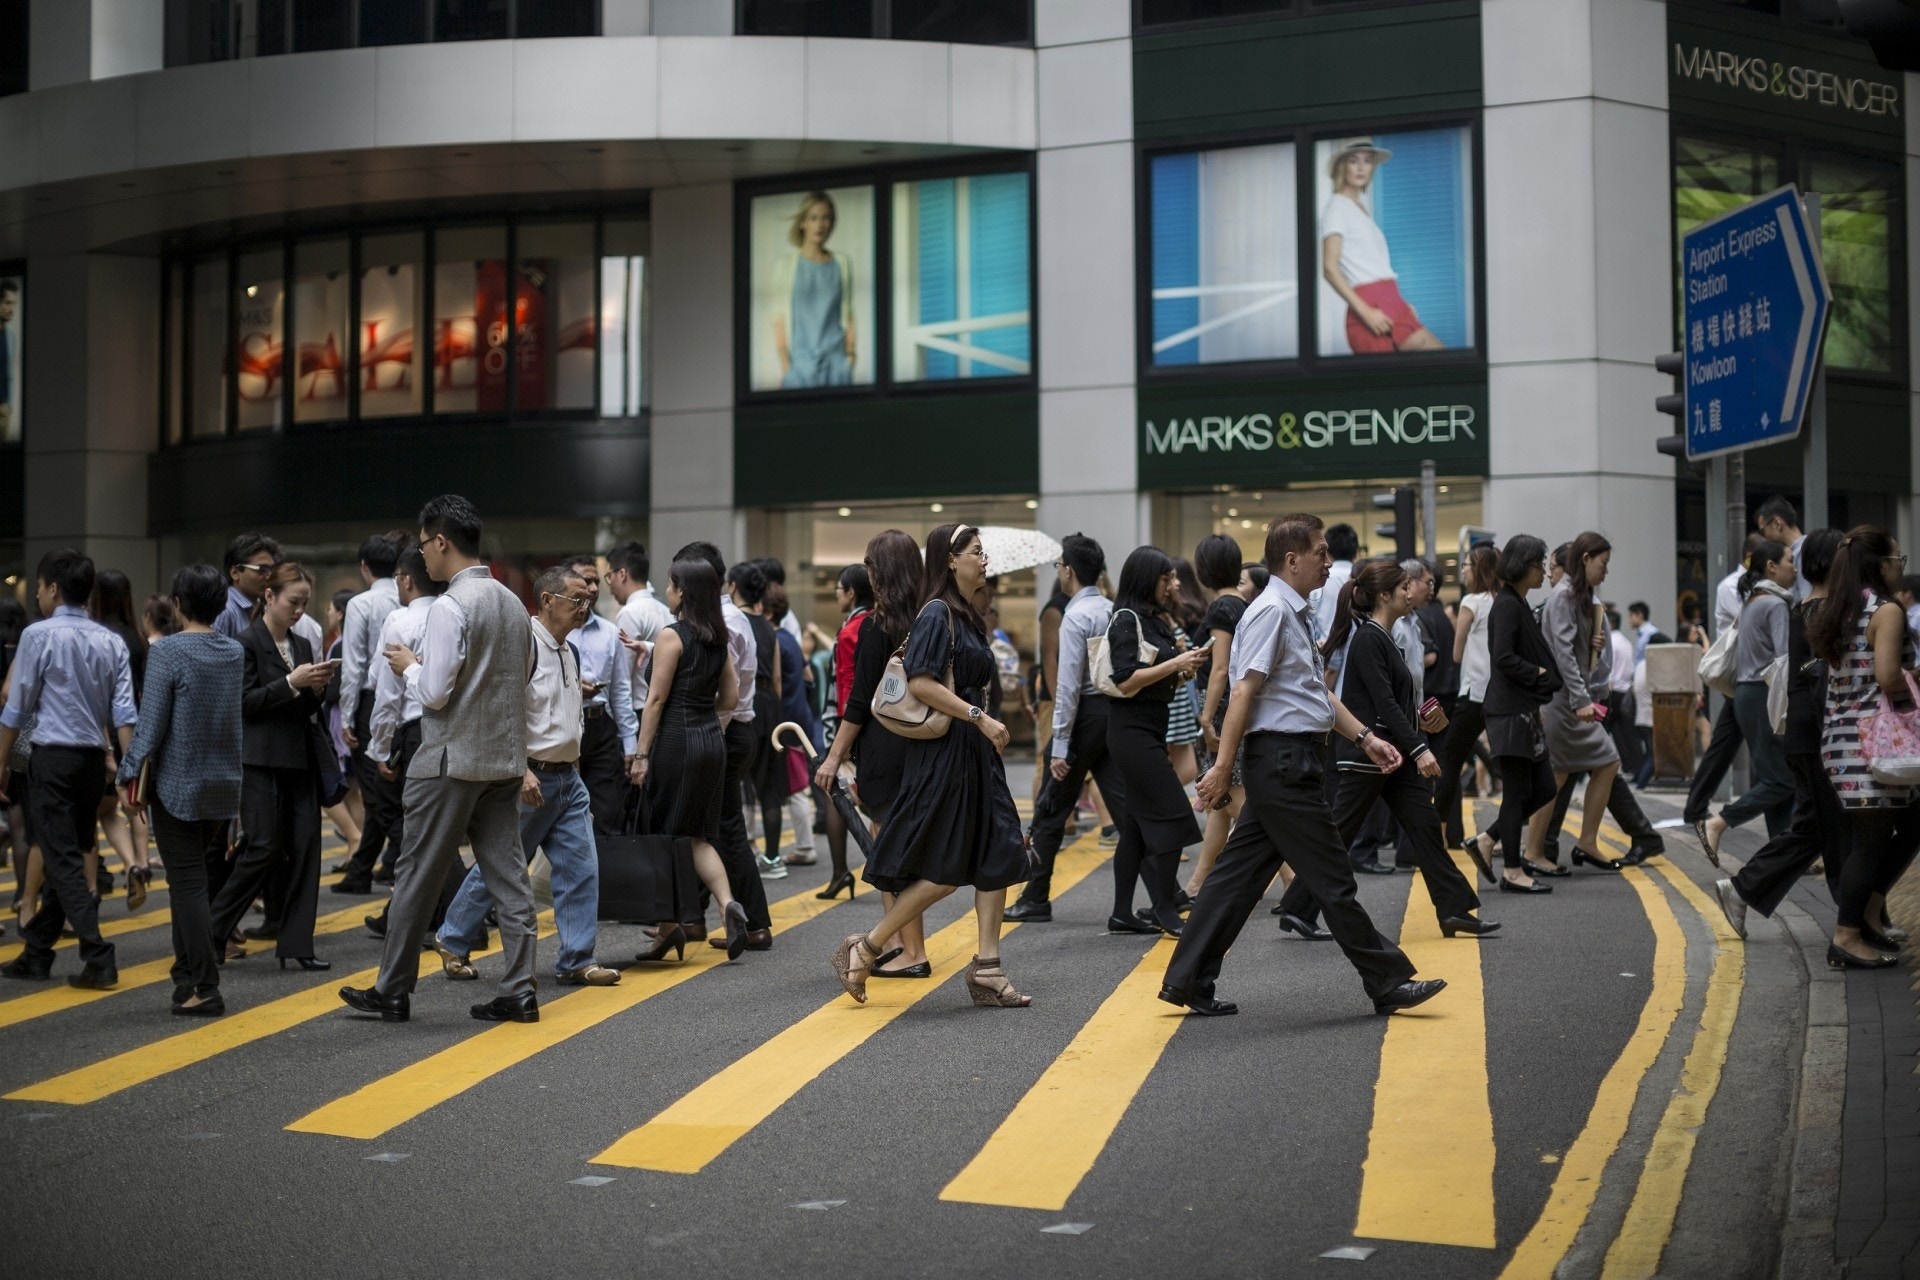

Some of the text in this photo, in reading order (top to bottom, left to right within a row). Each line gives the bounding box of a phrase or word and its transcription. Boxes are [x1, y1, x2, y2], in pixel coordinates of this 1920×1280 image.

[1689, 220, 1778, 275] Airport Express
[1689, 273, 1729, 305] Station
[1690, 355, 1738, 387] Kowloon
[1692, 398, 1723, 436] 九龍
